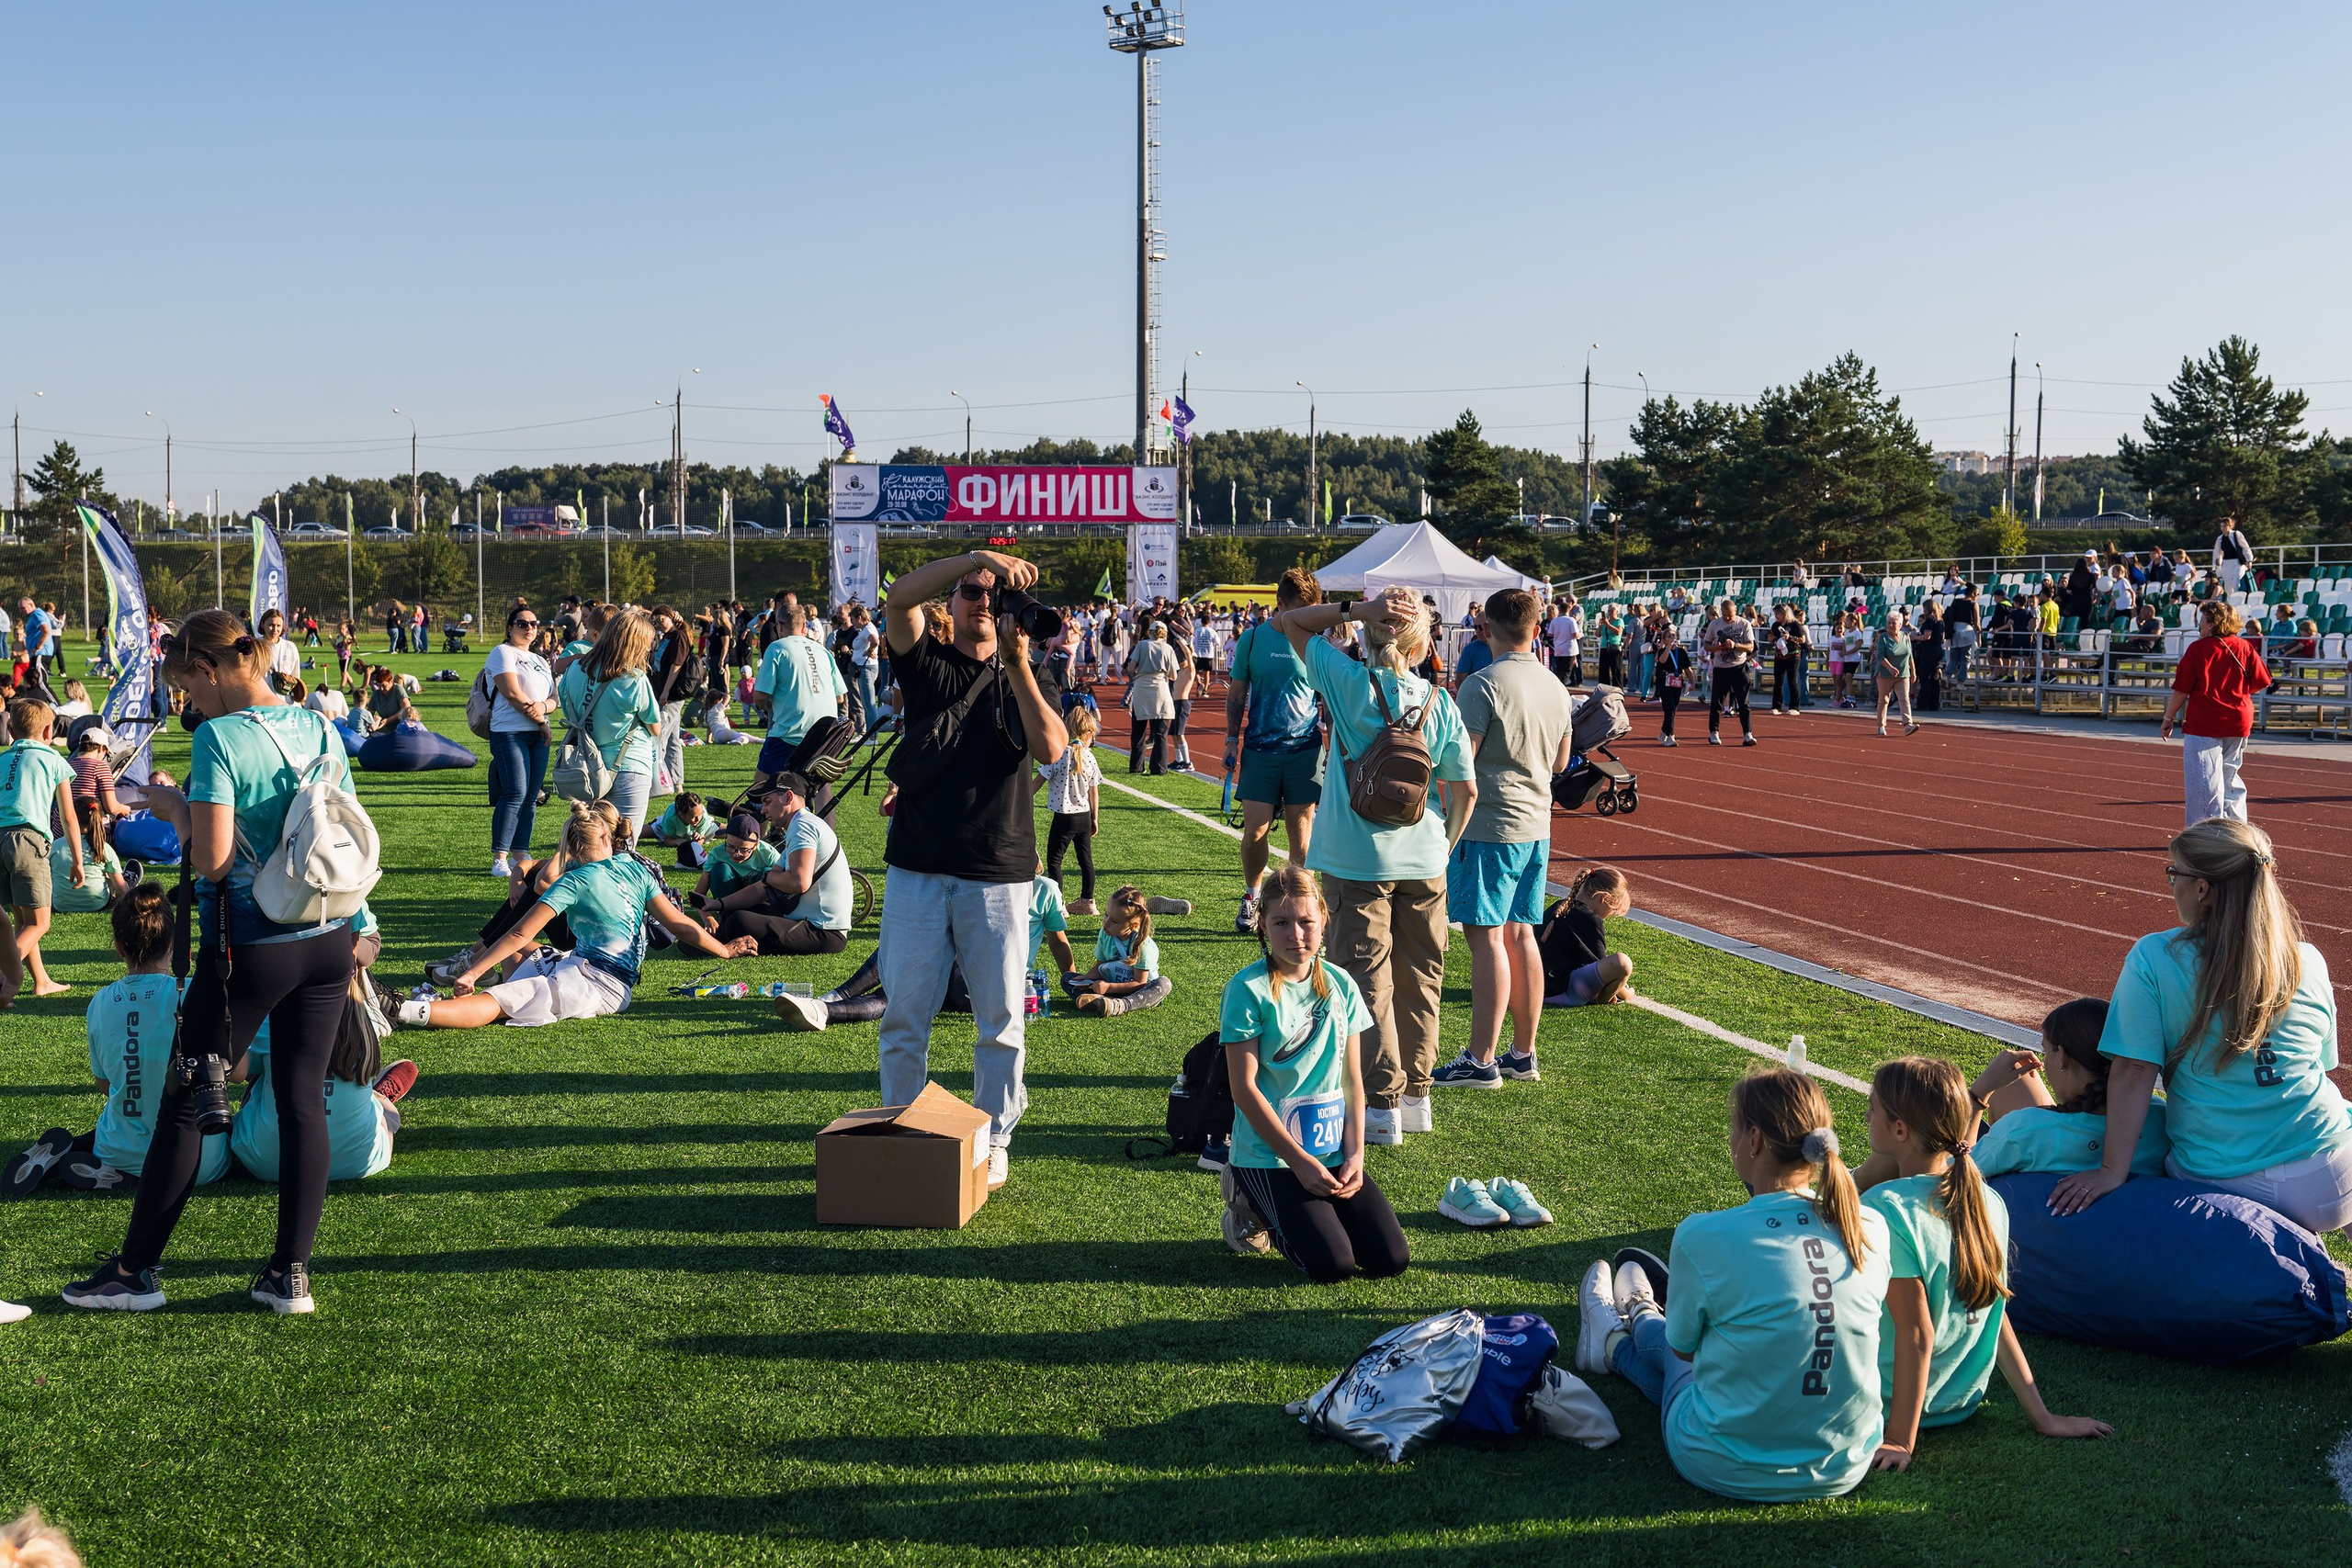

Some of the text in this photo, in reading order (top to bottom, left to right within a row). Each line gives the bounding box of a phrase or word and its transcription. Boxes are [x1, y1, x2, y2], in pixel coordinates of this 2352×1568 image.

[887, 489, 944, 502] МАРАФОН
[902, 475, 944, 484] КАЛУЖСКИЙ
[958, 474, 1127, 516] ФИНИШ
[805, 646, 820, 694] Pandora
[6, 746, 24, 791] Pandora
[123, 1011, 142, 1118] Pandora
[1802, 1237, 1836, 1396] Pandora
[1482, 1347, 1511, 1366] able
[1340, 1379, 1385, 1413] appy
